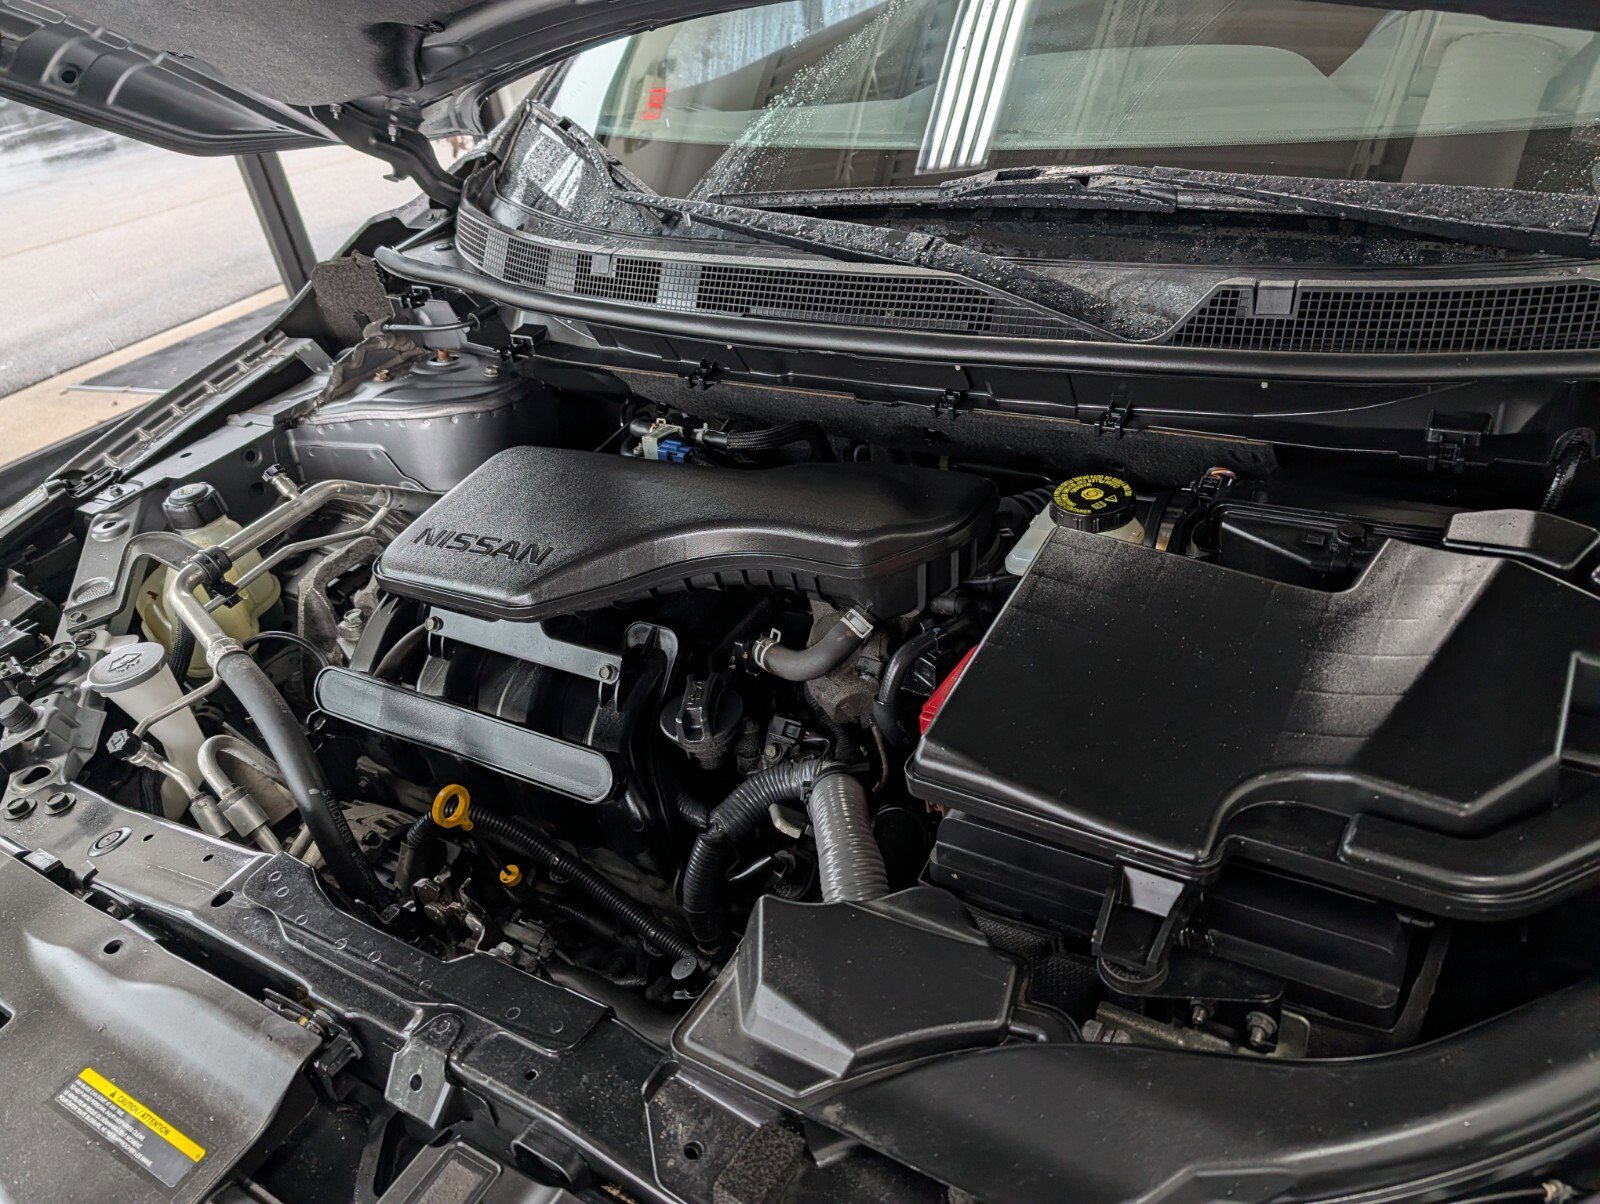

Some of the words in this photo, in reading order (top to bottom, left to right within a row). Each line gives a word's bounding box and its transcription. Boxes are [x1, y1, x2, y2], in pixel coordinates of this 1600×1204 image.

[412, 528, 554, 567] NISSAN
[117, 1095, 137, 1114] CAUTION
[140, 1112, 171, 1136] ATTENTION
